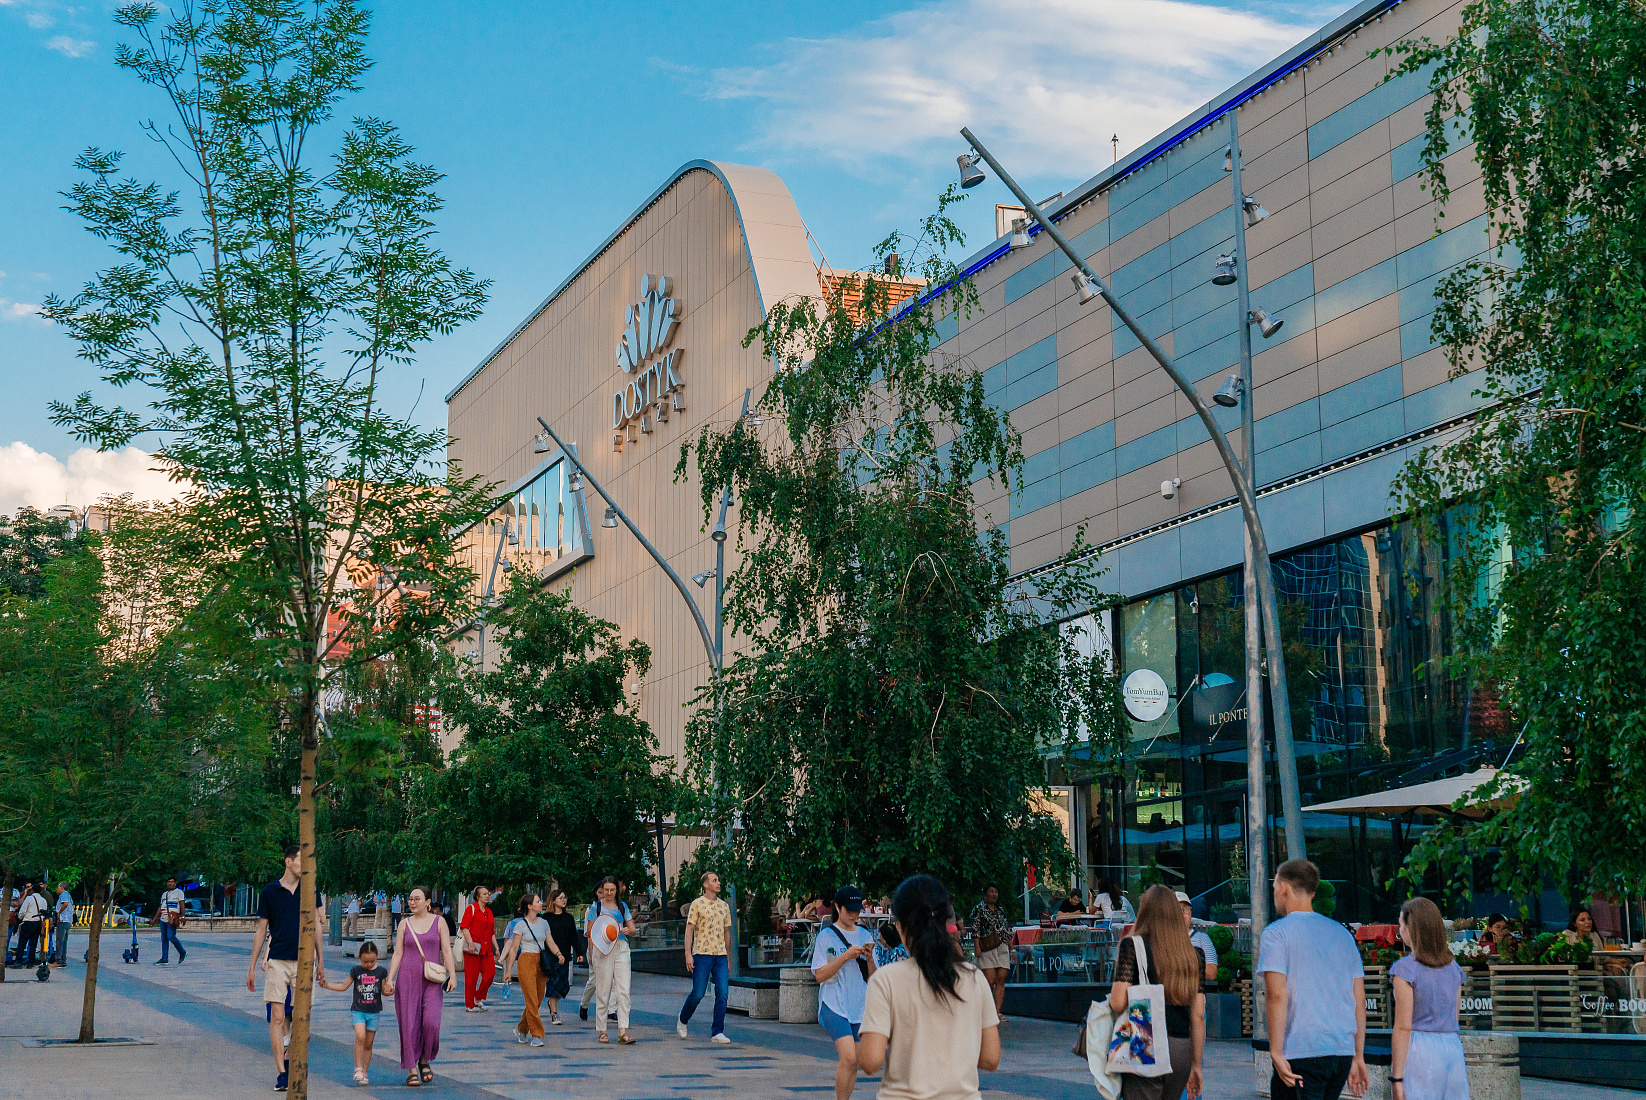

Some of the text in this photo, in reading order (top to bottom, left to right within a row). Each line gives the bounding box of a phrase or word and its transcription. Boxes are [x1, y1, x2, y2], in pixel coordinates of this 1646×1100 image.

[612, 348, 685, 430] DOSTYK
[612, 391, 686, 453] PLAZA
[1125, 687, 1164, 696] TomYumBar
[1209, 708, 1248, 726] IL PONTE
[1038, 955, 1083, 972] IL PONTE
[1459, 997, 1493, 1010] BOOM
[1580, 993, 1615, 1017] Coffee
